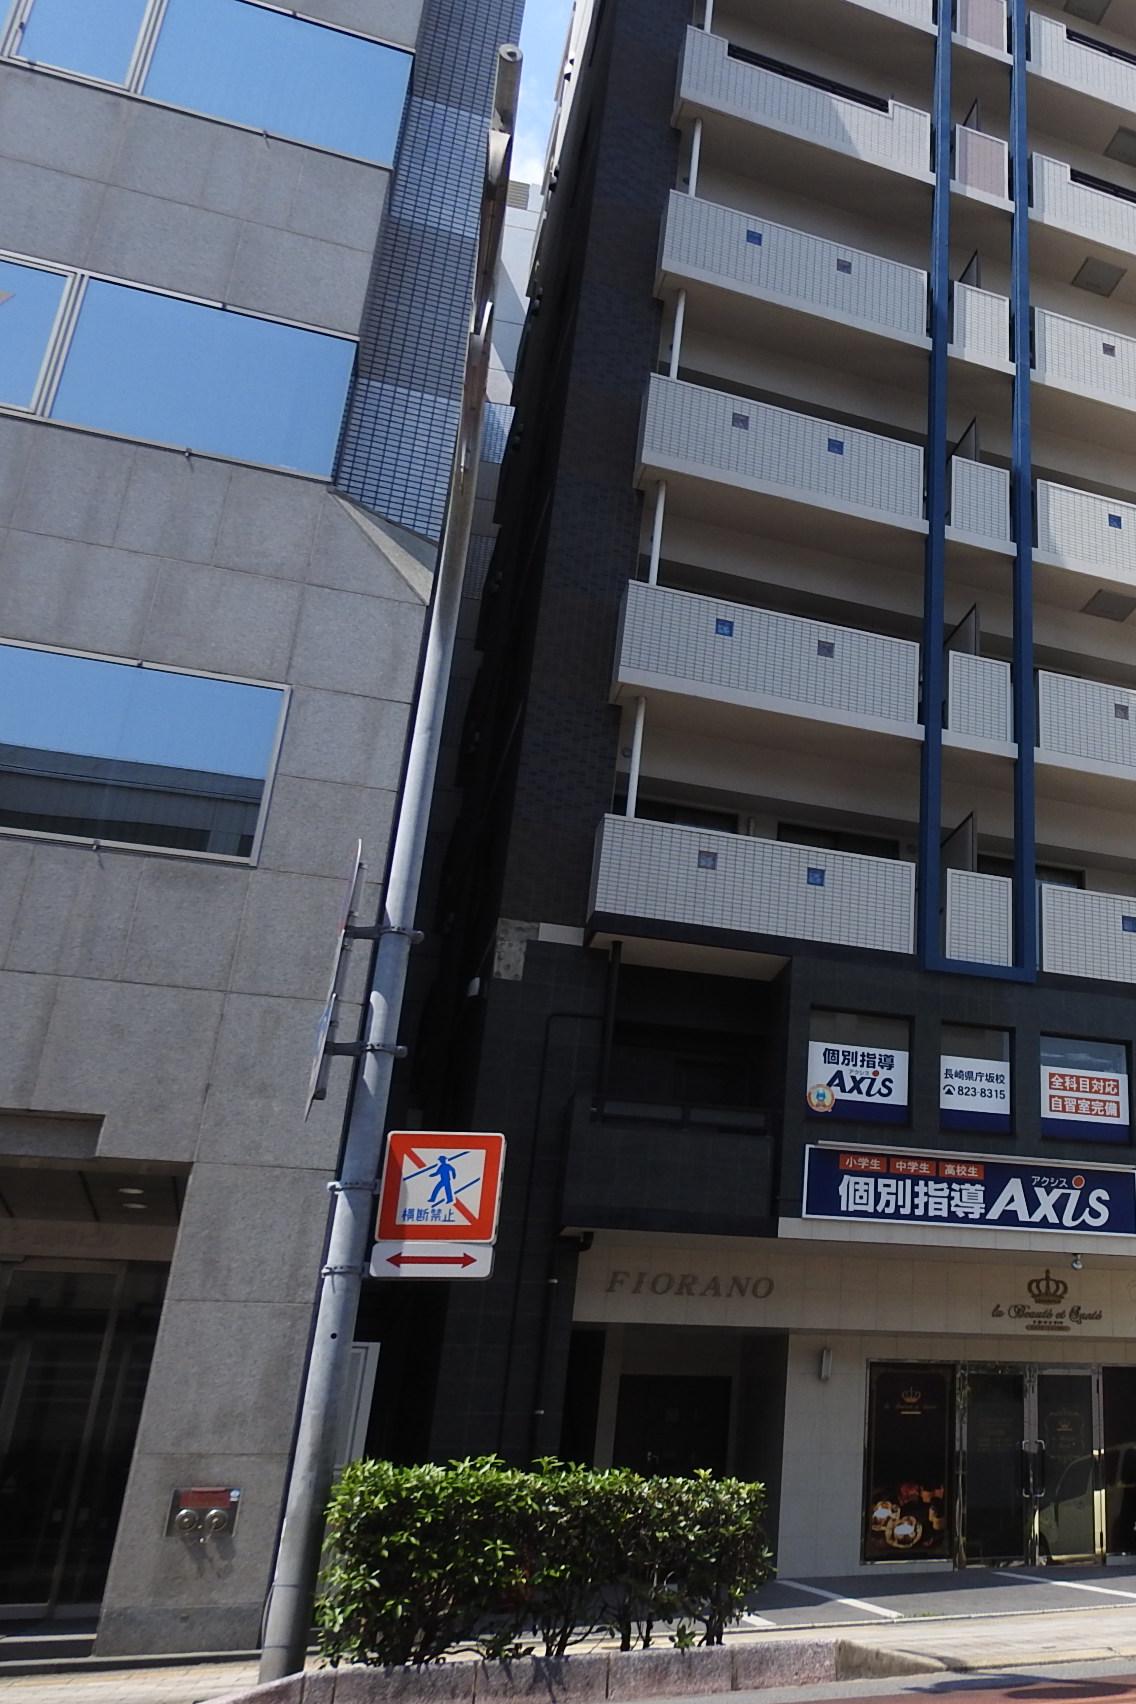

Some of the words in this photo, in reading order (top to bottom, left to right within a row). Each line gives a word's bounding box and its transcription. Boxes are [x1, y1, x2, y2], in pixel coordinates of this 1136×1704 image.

[823, 1048, 894, 1071] 個別指導
[944, 1068, 1006, 1085] 長崎県庁坂校
[1050, 1074, 1118, 1095] 全科目対応
[957, 1085, 1006, 1100] 823-8315
[1050, 1097, 1118, 1117] 自習室完備
[845, 1157, 881, 1171] 小学生
[895, 1161, 931, 1175] 中学生
[944, 1163, 979, 1178] 高校生
[1031, 1175, 1068, 1188] アクシス
[838, 1174, 986, 1219] 個別指導
[401, 1208, 455, 1222] 横断禁止
[605, 1271, 775, 1299] FIORANO
